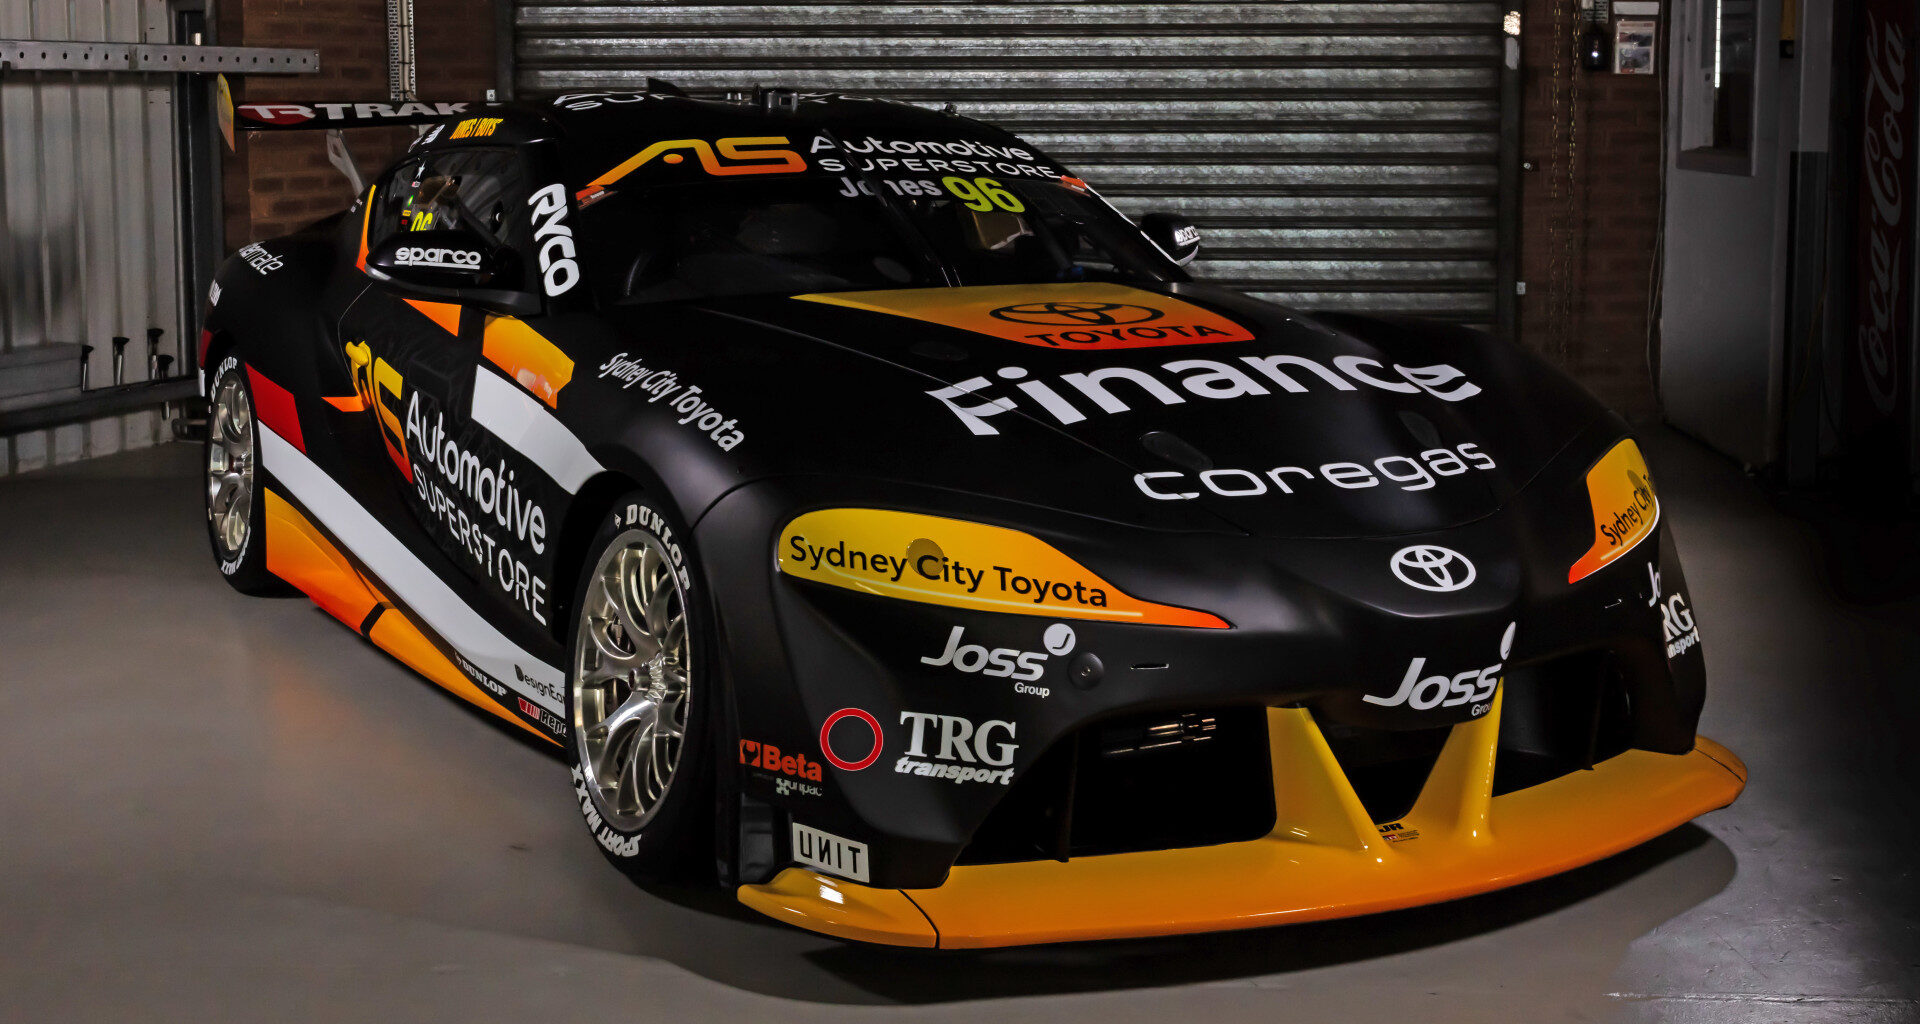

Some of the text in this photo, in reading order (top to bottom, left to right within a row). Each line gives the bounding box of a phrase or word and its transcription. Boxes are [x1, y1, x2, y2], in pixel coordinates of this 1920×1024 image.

[314, 102, 470, 120] TRAK
[810, 135, 1035, 162] Automotive
[818, 157, 1065, 180] SUPERSTORE
[942, 176, 1026, 213] 96
[395, 245, 481, 266] sparco
[528, 183, 580, 298] RYCO
[1024, 324, 1228, 348] TOYOTA
[598, 352, 745, 452] Sydney City Toyota
[926, 350, 1482, 436] Finance
[406, 390, 546, 555] Automotive
[1133, 441, 1497, 501] coregas
[412, 463, 547, 626] SUPERSTORE
[625, 503, 691, 592] DUNLOP
[1600, 502, 1643, 546] Sydney
[789, 535, 1108, 608] Sydney City Toyota
[1660, 592, 1694, 642] RG
[462, 660, 508, 697] DUNLOP
[920, 626, 1048, 682] Joss
[1014, 682, 1050, 699] Group
[1362, 657, 1503, 711] Joss
[762, 743, 823, 783] Beta
[898, 710, 1019, 767] TRG
[894, 756, 1014, 786] transport
[570, 763, 642, 857] SPORT MAXX
